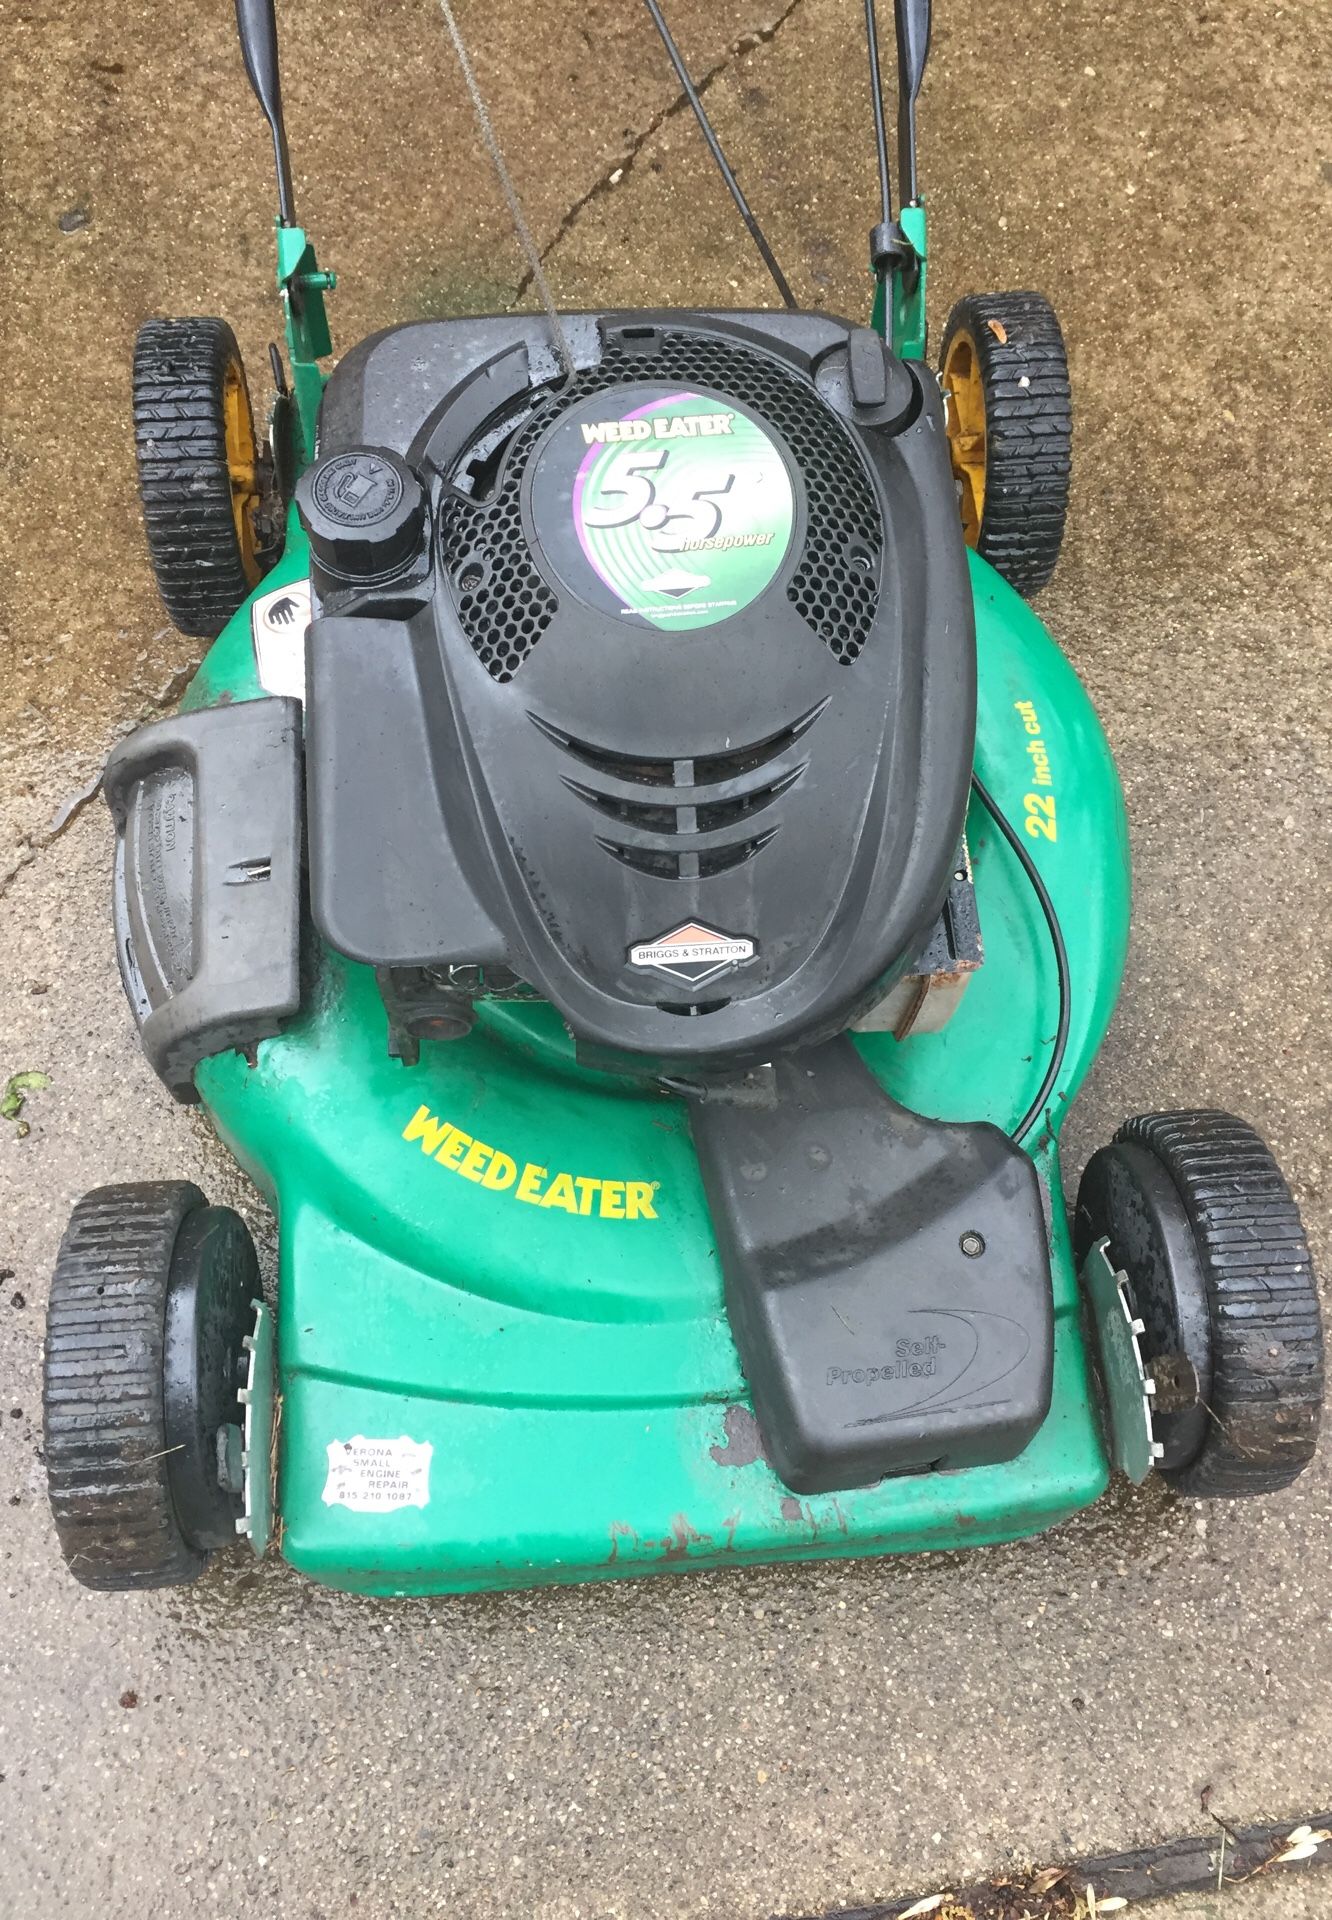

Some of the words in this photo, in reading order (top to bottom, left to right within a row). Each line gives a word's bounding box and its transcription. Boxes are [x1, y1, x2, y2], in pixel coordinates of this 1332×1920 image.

[581, 419, 651, 444] WEED
[652, 414, 735, 439] EATER
[583, 449, 735, 554] 5.5
[679, 532, 775, 552] horsepower
[1014, 700, 1041, 735] cut
[1026, 739, 1053, 786] inch
[1023, 792, 1057, 843] 22
[638, 949, 679, 960] BRIGGS
[682, 949, 689, 957] &
[691, 945, 746, 957] STRATTON
[401, 1103, 518, 1191] WEED
[514, 1162, 660, 1220] EATER
[895, 1334, 946, 1358] Self-
[826, 1356, 937, 1387] Propelled
[353, 1458, 391, 1467] SMALL
[360, 1469, 401, 1479] ENGINE
[362, 1491, 382, 1500] 210
[368, 1480, 409, 1489] REPAIR
